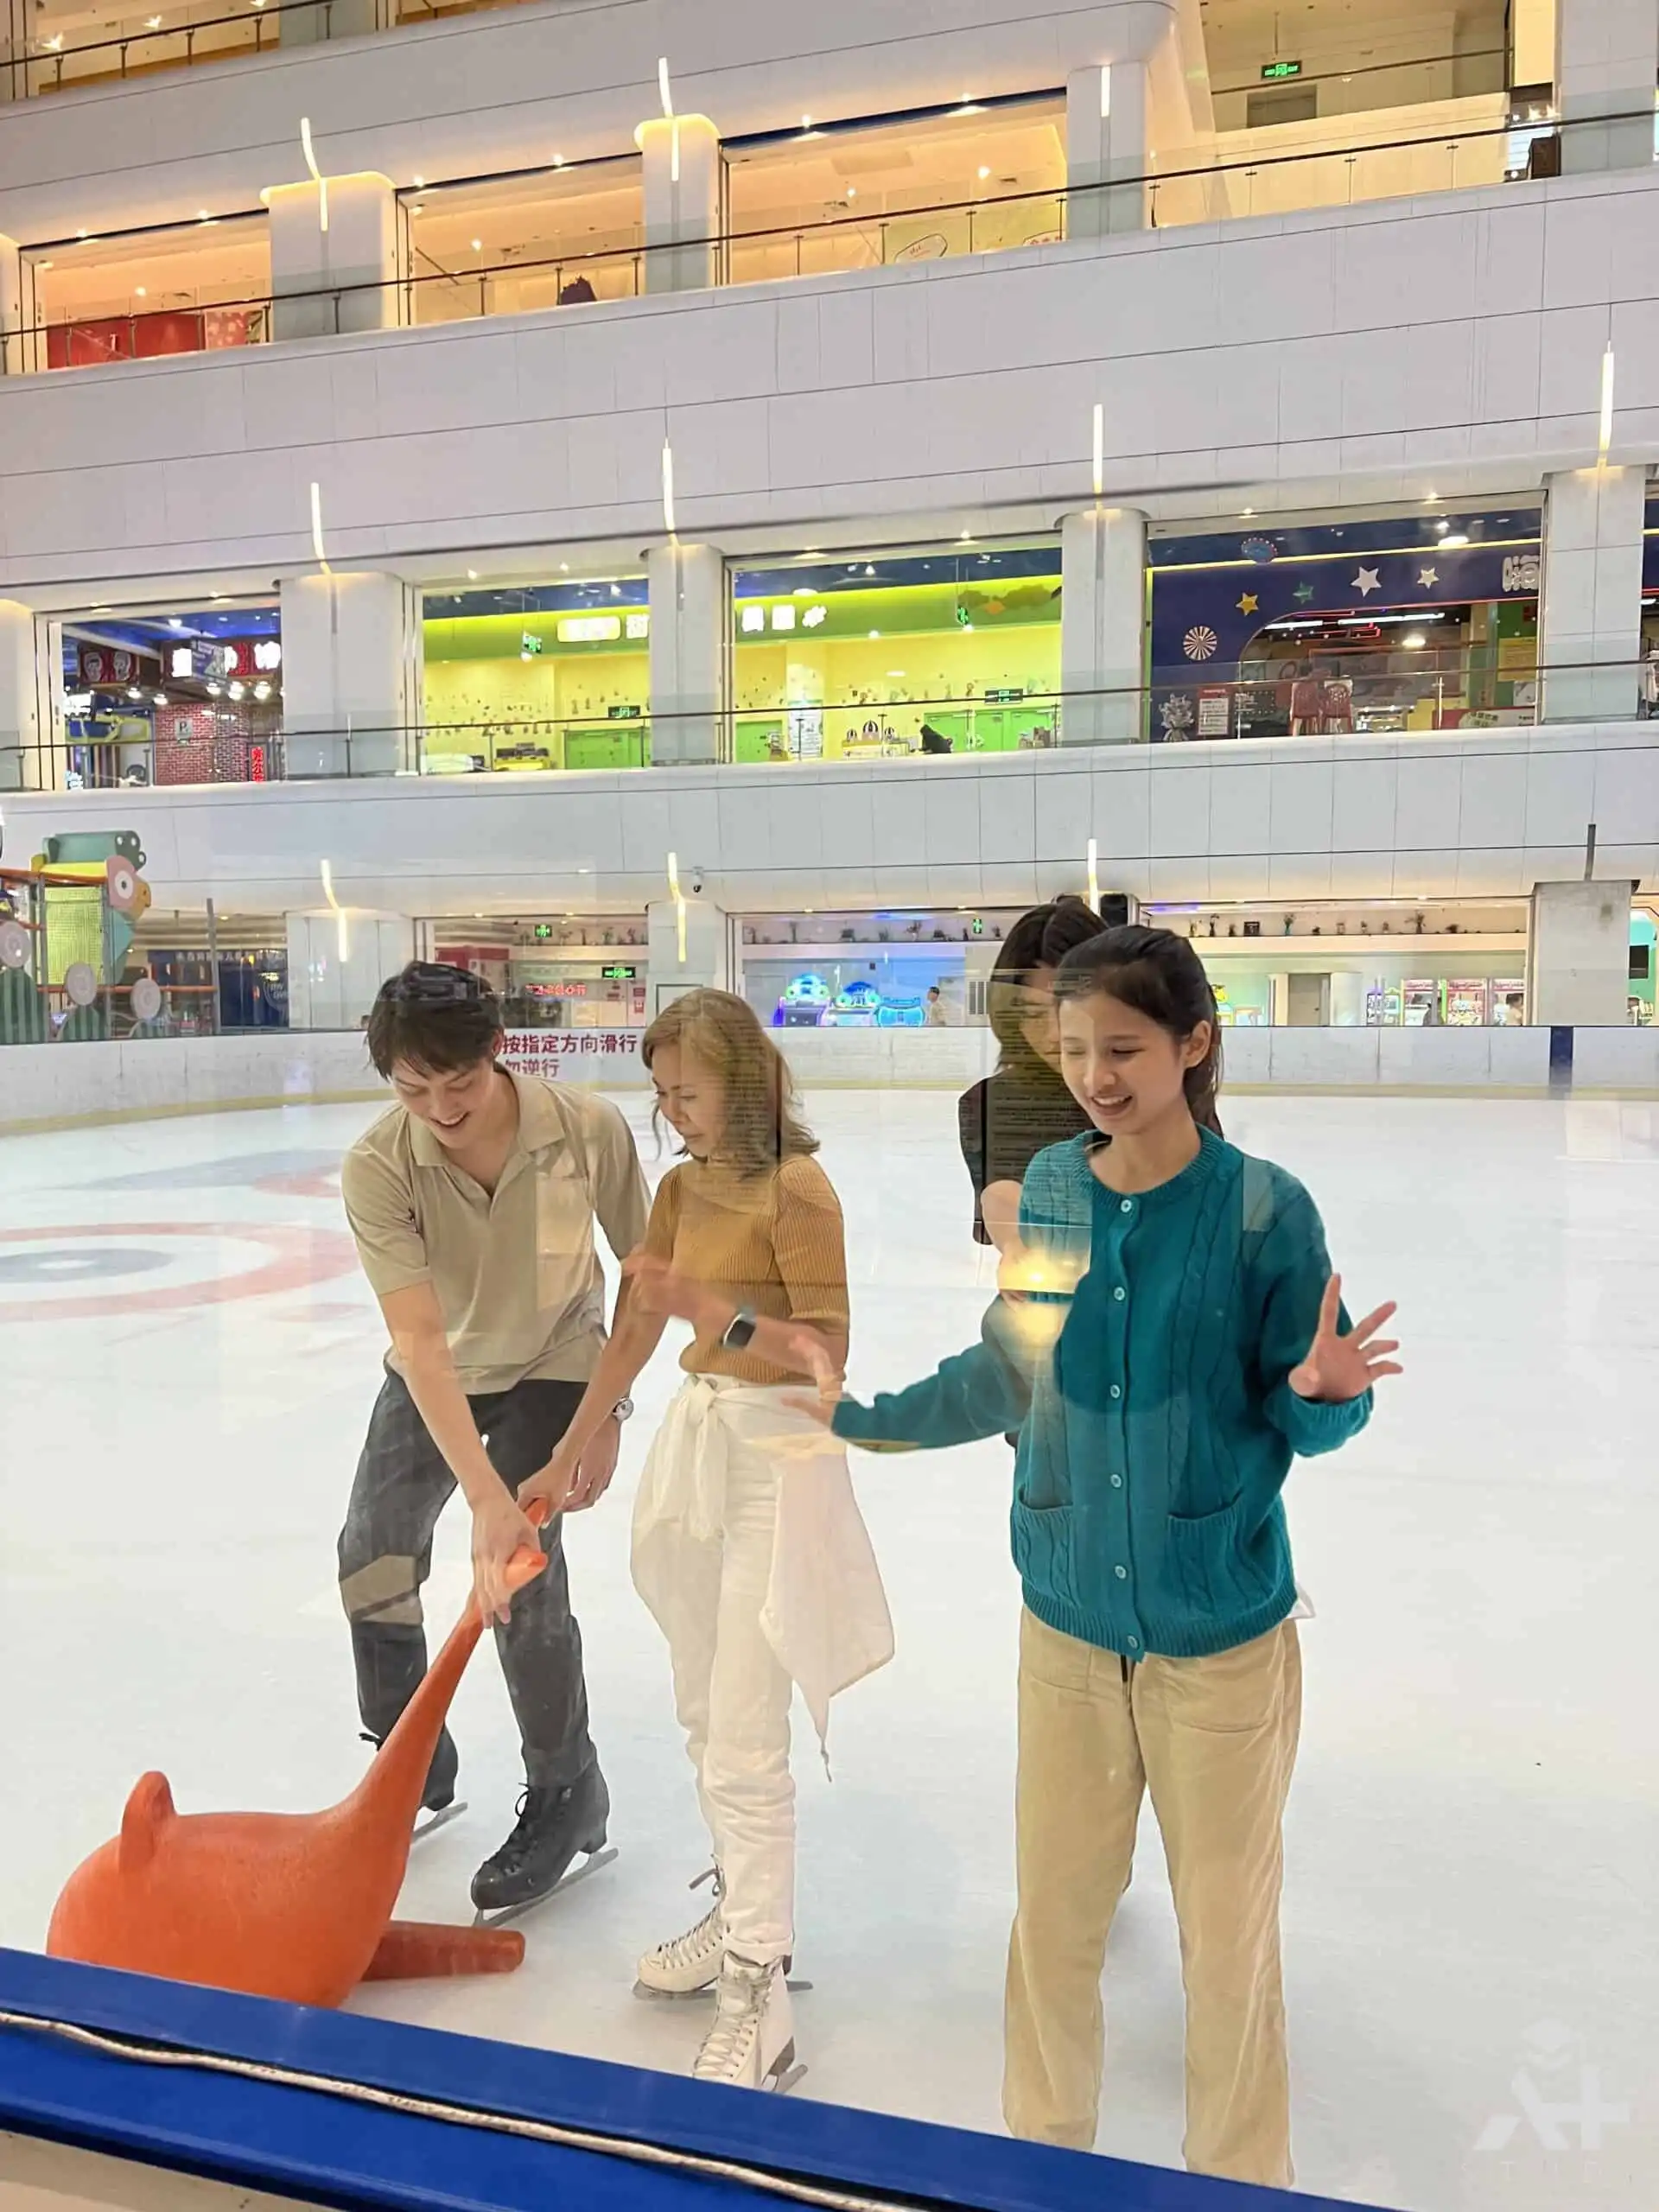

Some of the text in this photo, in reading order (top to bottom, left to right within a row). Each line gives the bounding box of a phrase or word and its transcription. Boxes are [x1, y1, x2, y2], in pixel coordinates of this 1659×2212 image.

[503, 1033, 637, 1054] 按指定方向滑行
